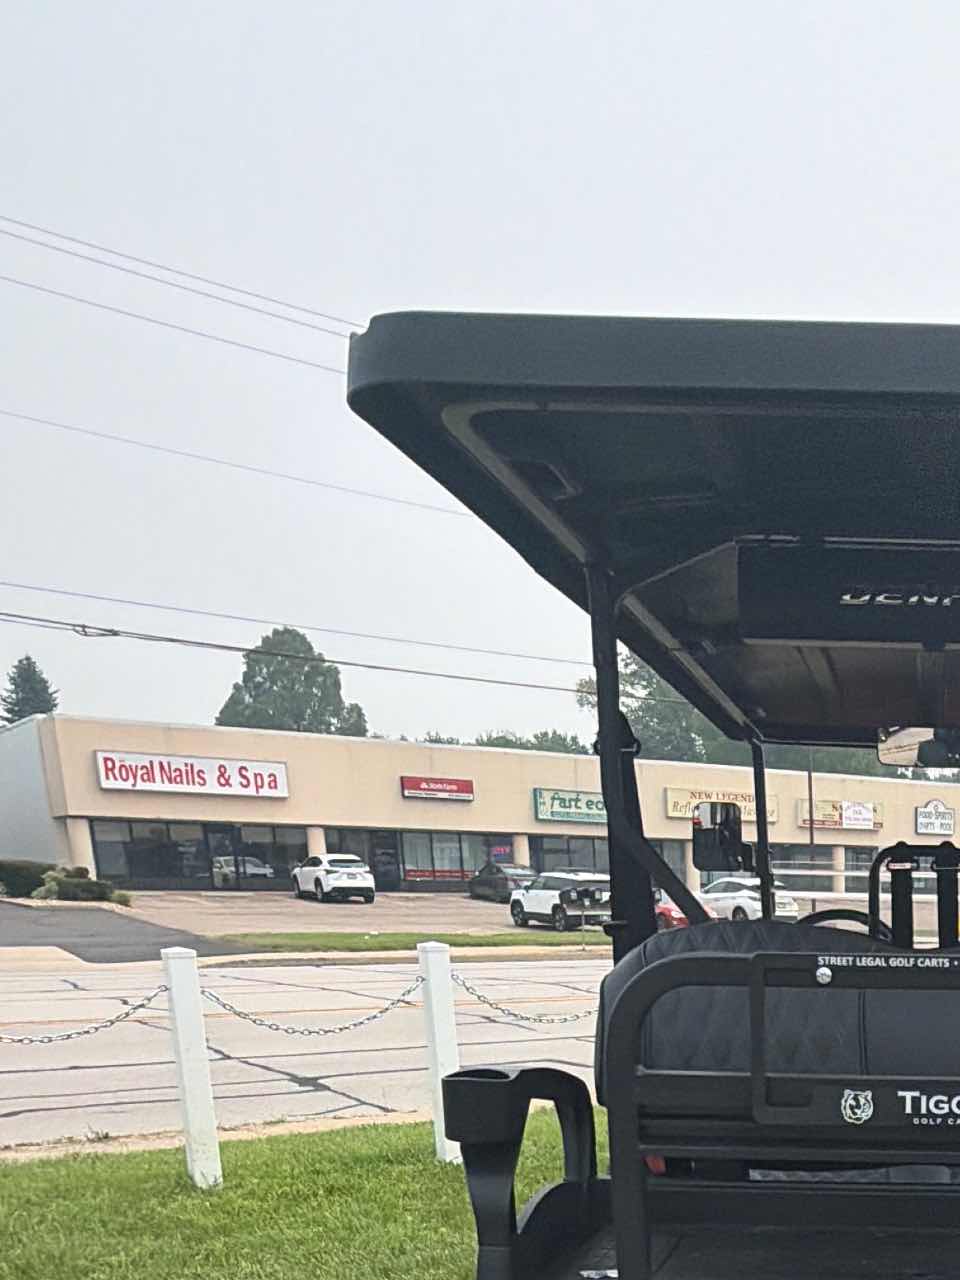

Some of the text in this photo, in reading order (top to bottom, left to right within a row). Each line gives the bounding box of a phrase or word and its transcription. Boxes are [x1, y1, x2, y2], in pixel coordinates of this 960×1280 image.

[103, 757, 278, 794] Royal Nails & Spa
[689, 791, 712, 801] NEW
[817, 956, 854, 966] STREET
[855, 957, 887, 967] LEGAL
[888, 957, 915, 968] GOLF
[917, 958, 950, 968] CARTS
[912, 1117, 942, 1125] GOLF
